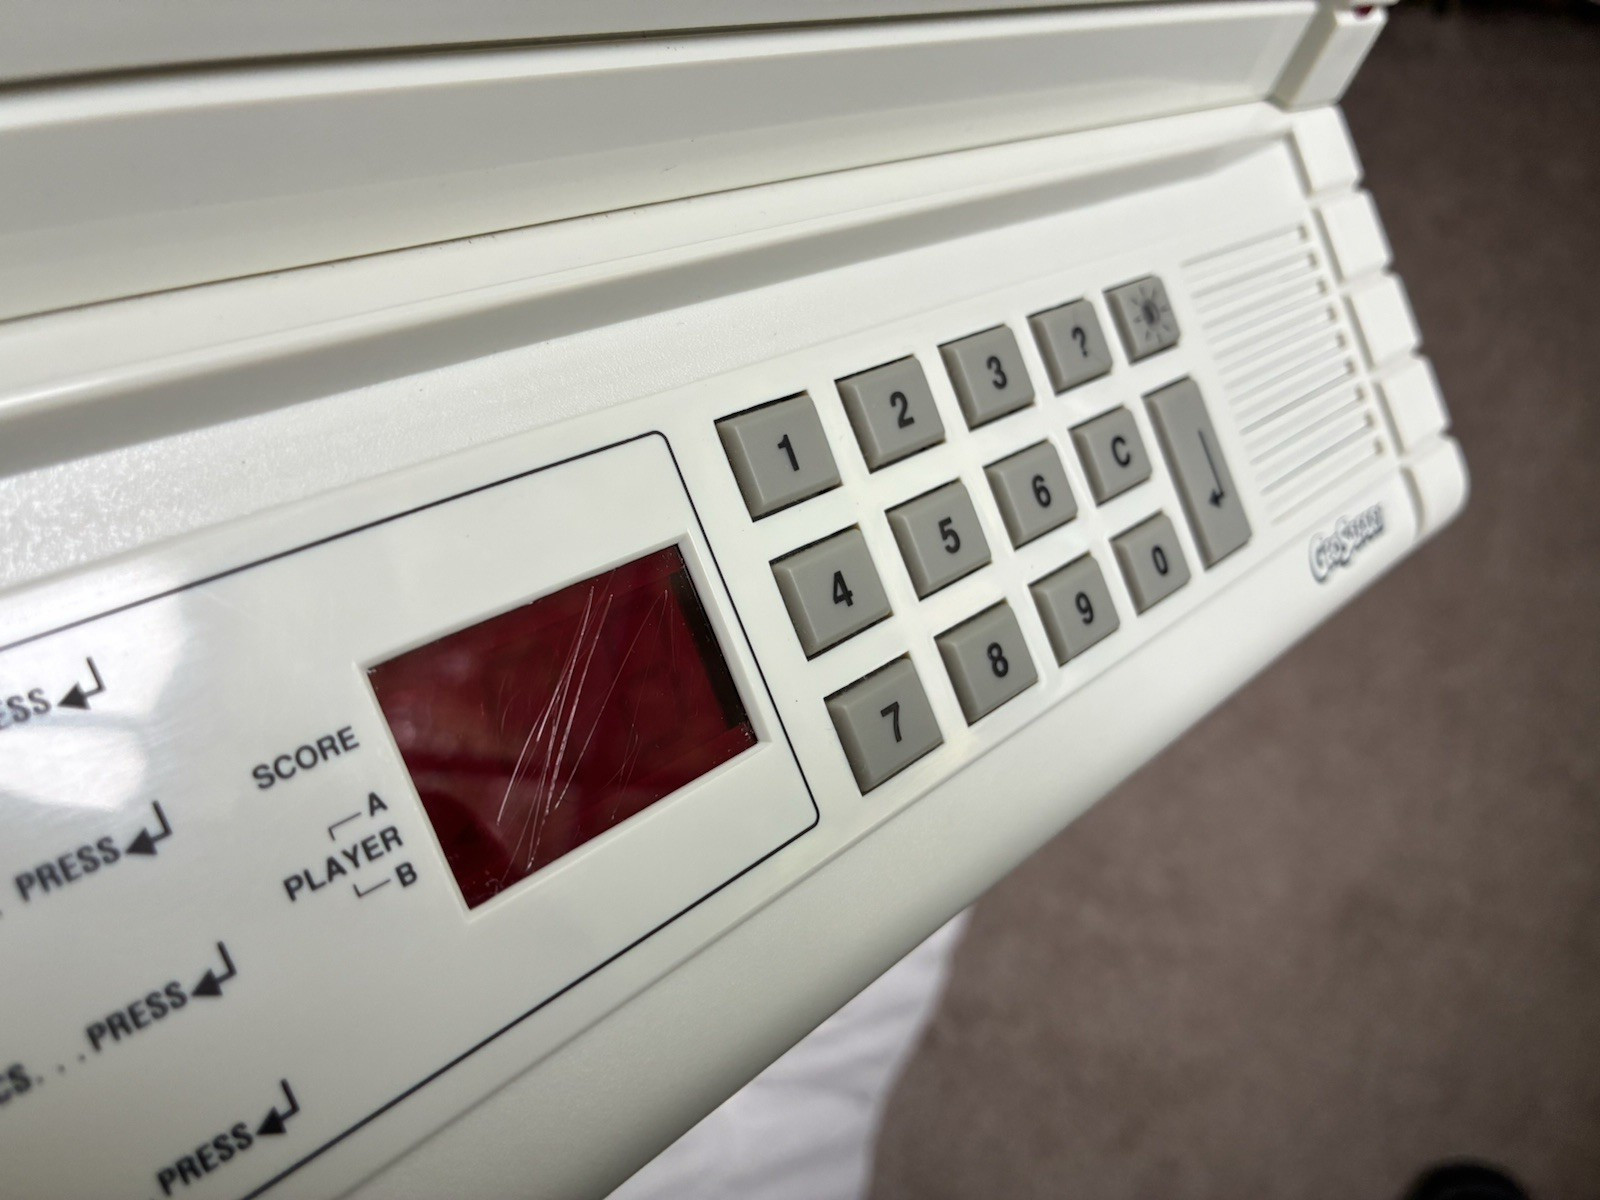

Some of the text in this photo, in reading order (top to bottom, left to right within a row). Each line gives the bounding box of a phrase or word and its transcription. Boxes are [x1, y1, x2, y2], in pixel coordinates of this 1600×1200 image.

[777, 325, 1089, 472] 1 2 3 ?
[831, 435, 1132, 608] 4 5 6 C
[880, 545, 1169, 744] 7 8 9 0
[251, 725, 361, 790] SCORE
[368, 791, 388, 818] A
[14, 835, 121, 903] PRESS
[283, 825, 404, 902] PLAYER
[394, 861, 418, 888] B
[85, 980, 189, 1052] PRESS
[156, 1121, 255, 1198] PRESS
